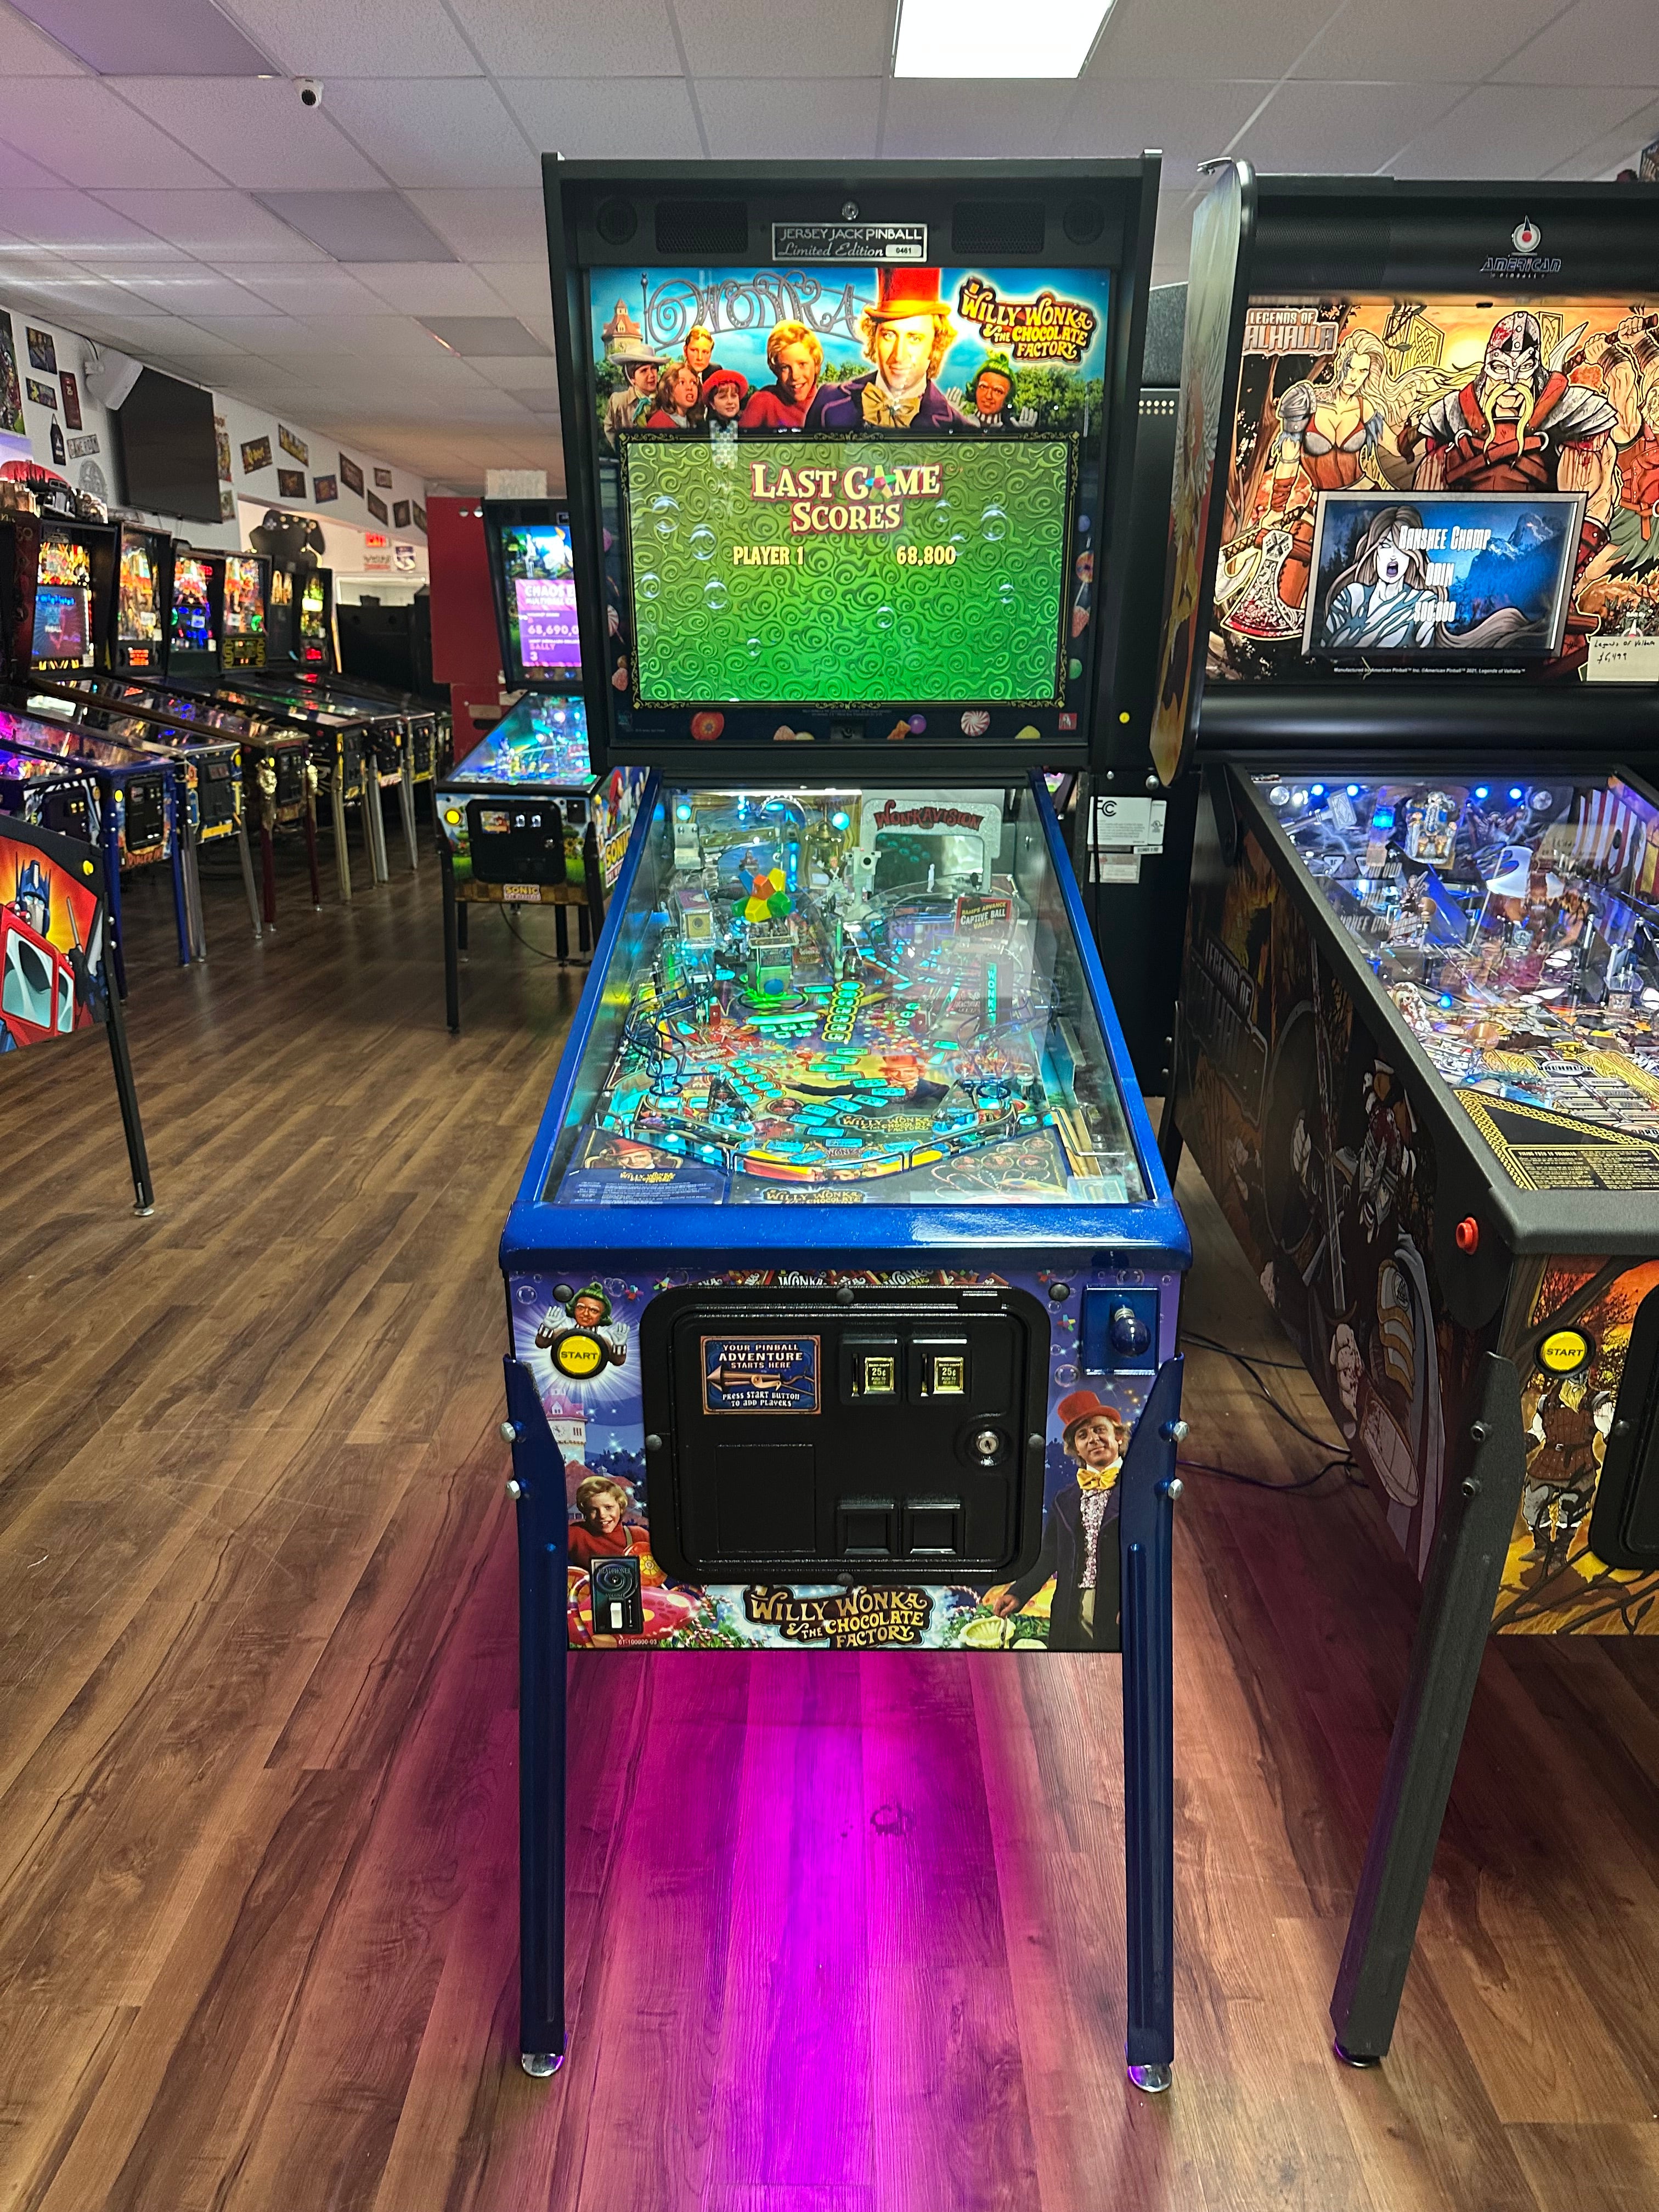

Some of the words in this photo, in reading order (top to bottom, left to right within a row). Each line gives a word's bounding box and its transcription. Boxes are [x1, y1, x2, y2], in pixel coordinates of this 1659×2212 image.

[780, 228, 828, 241] JERSEY
[828, 228, 864, 241] JACK
[865, 228, 922, 241] PINBALL
[778, 240, 831, 257] Limited
[835, 242, 884, 257] Edition
[961, 290, 1022, 327] WILLY
[1025, 297, 1093, 330] WONKA
[1250, 312, 1297, 325] LEGENDS
[1300, 312, 1315, 325] OF
[994, 332, 1011, 343] THE
[1012, 325, 1088, 347] CHOCOLATE
[1243, 325, 1335, 352] ALHALLA
[1017, 341, 1077, 359] FACTORY
[751, 463, 839, 500] LAST
[843, 464, 942, 501] GAME
[791, 501, 902, 533] SCORES
[1398, 525, 1448, 551] BANSHEE
[1450, 526, 1492, 552] CHAMP
[732, 546, 791, 566] PLAYER
[797, 546, 804, 565] 1
[896, 545, 957, 567] 68,800
[1425, 562, 1455, 588] ODIN
[524, 584, 565, 597] CHAOS
[527, 624, 579, 637] 68,690,0
[873, 799, 985, 831] WONKAVISION
[505, 885, 539, 895] SONIC
[960, 911, 989, 926] CAPTIVE
[990, 908, 1006, 919] BALL
[973, 918, 995, 930] VALUE
[843, 1115, 883, 1126] WILLY
[766, 1189, 809, 1201] WILLY
[561, 1351, 598, 1360] START
[719, 1352, 803, 1362] ADVENTURE
[1546, 1348, 1584, 1357] START
[751, 1592, 830, 1621] WILLY
[835, 1585, 928, 1617] WONKA
[802, 1628, 823, 1639] THE
[824, 1610, 924, 1635] CHOCOLATE
[837, 1625, 915, 1648] FACTORY
